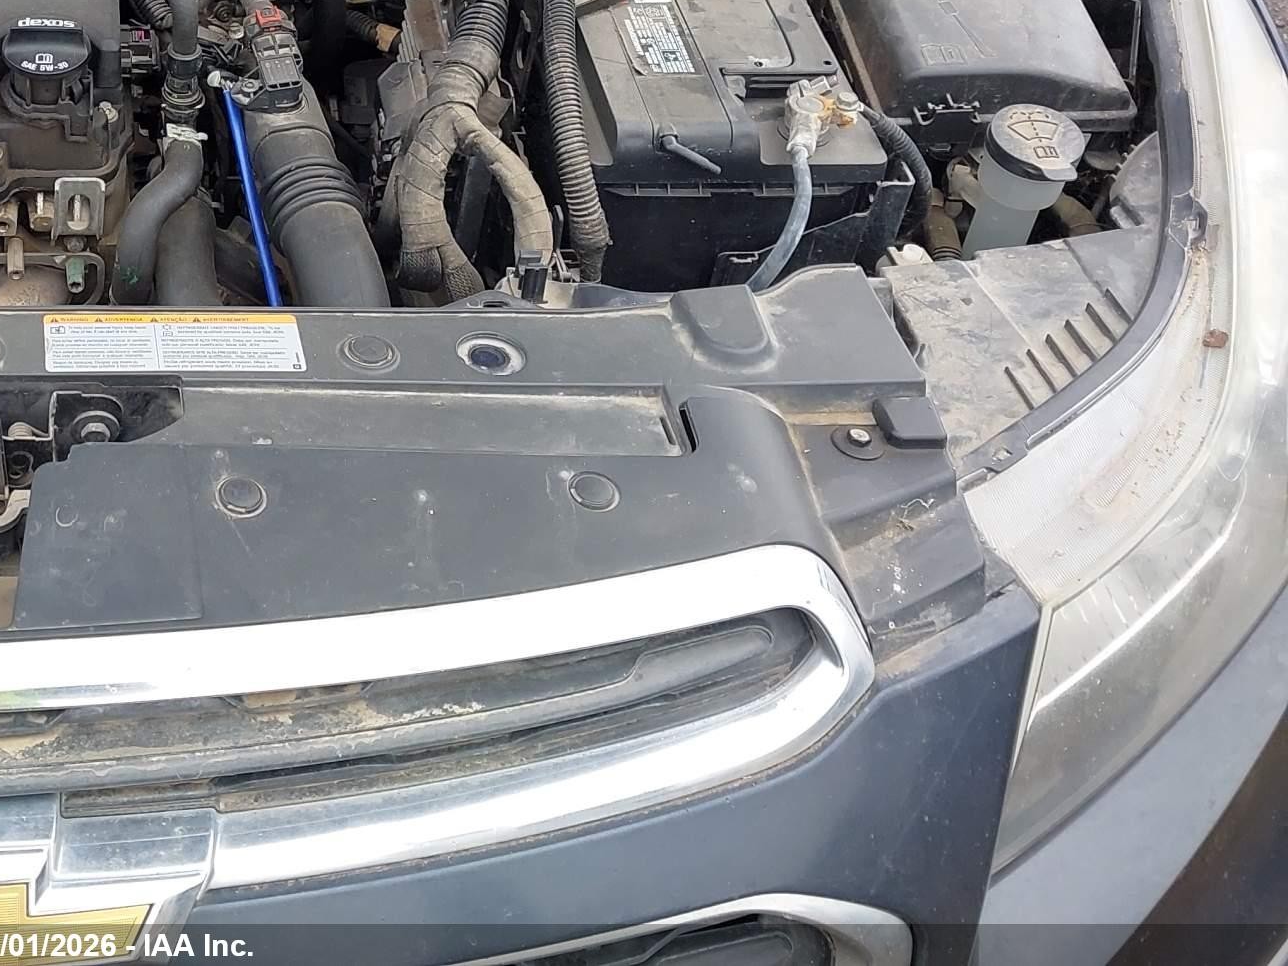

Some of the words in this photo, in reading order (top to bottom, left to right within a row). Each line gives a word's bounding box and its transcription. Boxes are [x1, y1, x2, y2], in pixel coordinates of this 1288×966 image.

[17, 17, 75, 28] dexos
[20, 60, 38, 71] SAE
[39, 61, 69, 72] 5W-30
